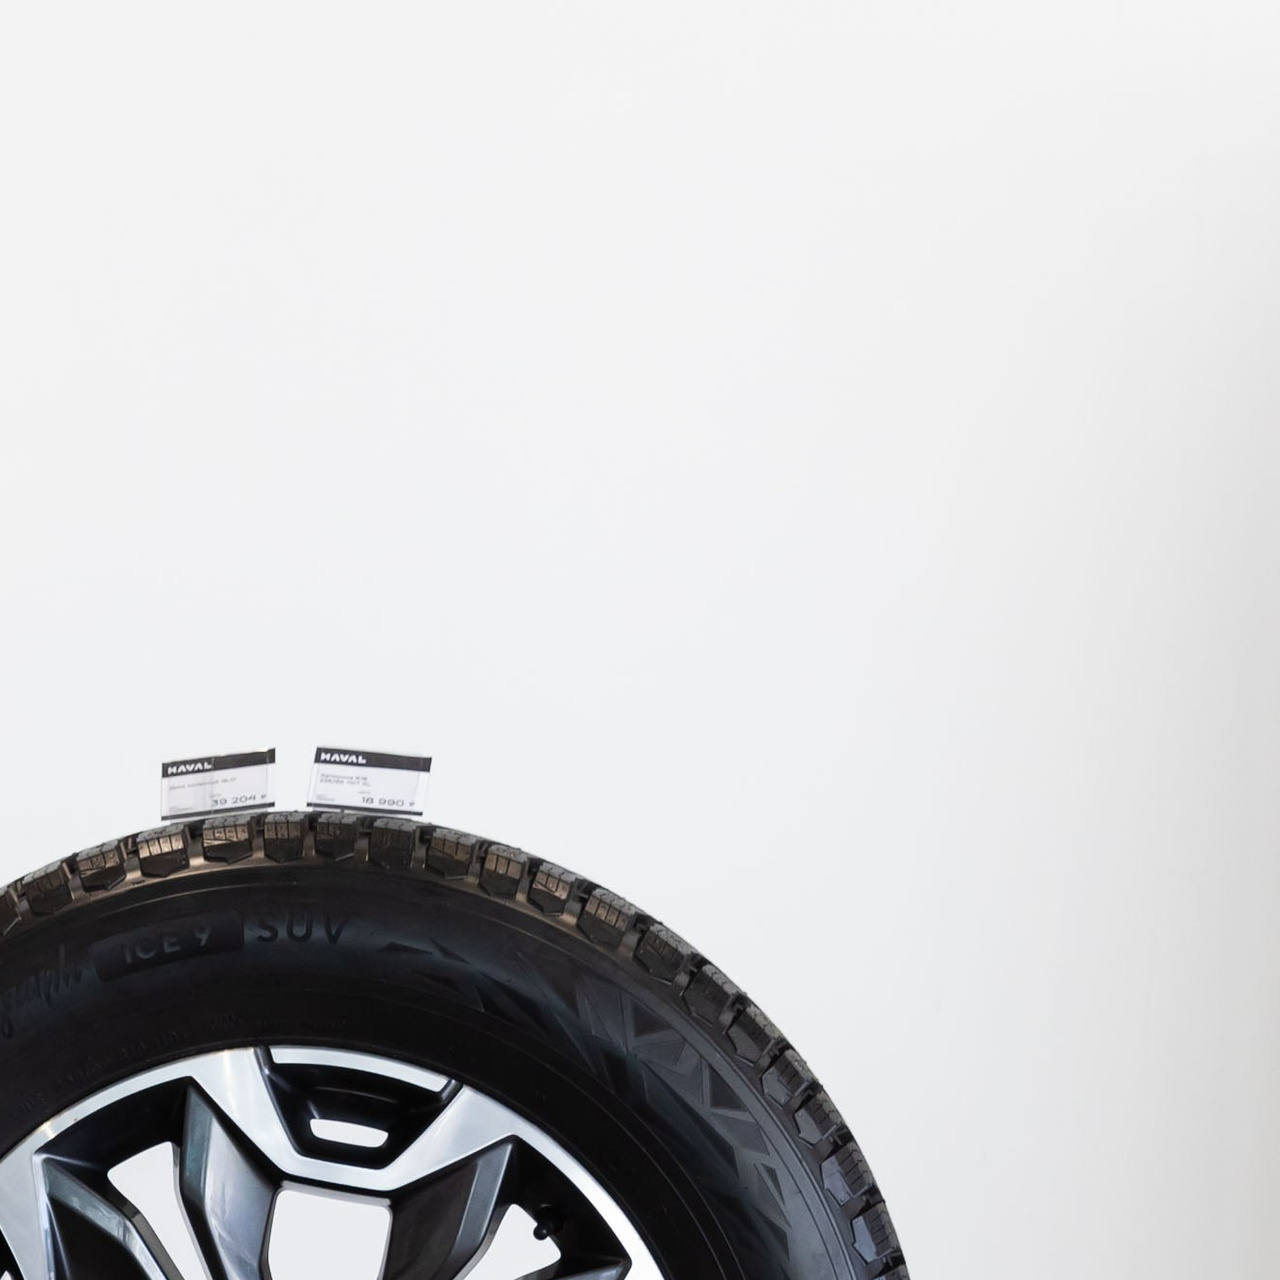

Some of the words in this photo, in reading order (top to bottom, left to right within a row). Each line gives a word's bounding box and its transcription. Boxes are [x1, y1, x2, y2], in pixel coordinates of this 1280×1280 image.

[321, 752, 367, 764] HAVAL
[167, 761, 212, 775] HAVAL
[120, 930, 179, 965] ICE
[191, 922, 212, 948] 9
[256, 911, 349, 945] SUV
